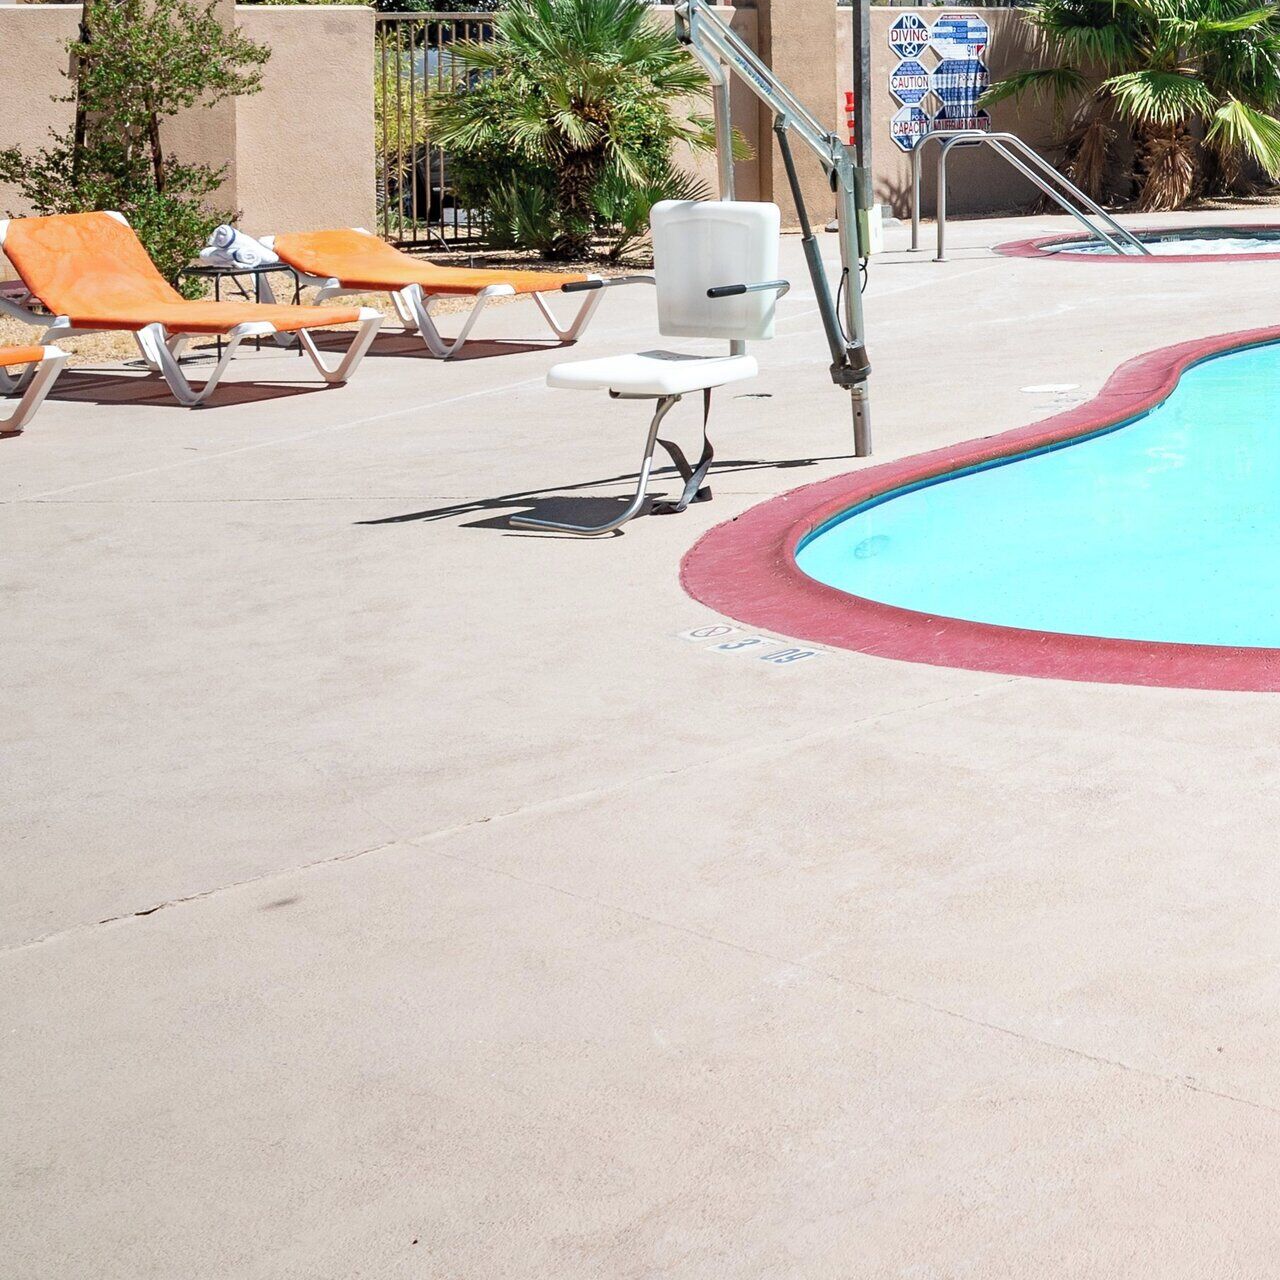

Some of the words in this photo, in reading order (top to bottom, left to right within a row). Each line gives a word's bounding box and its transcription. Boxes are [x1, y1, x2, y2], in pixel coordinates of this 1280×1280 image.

[903, 15, 918, 28] NO
[890, 28, 929, 42] DIVING
[891, 76, 929, 89] CAUTION
[945, 105, 978, 118] WARNING
